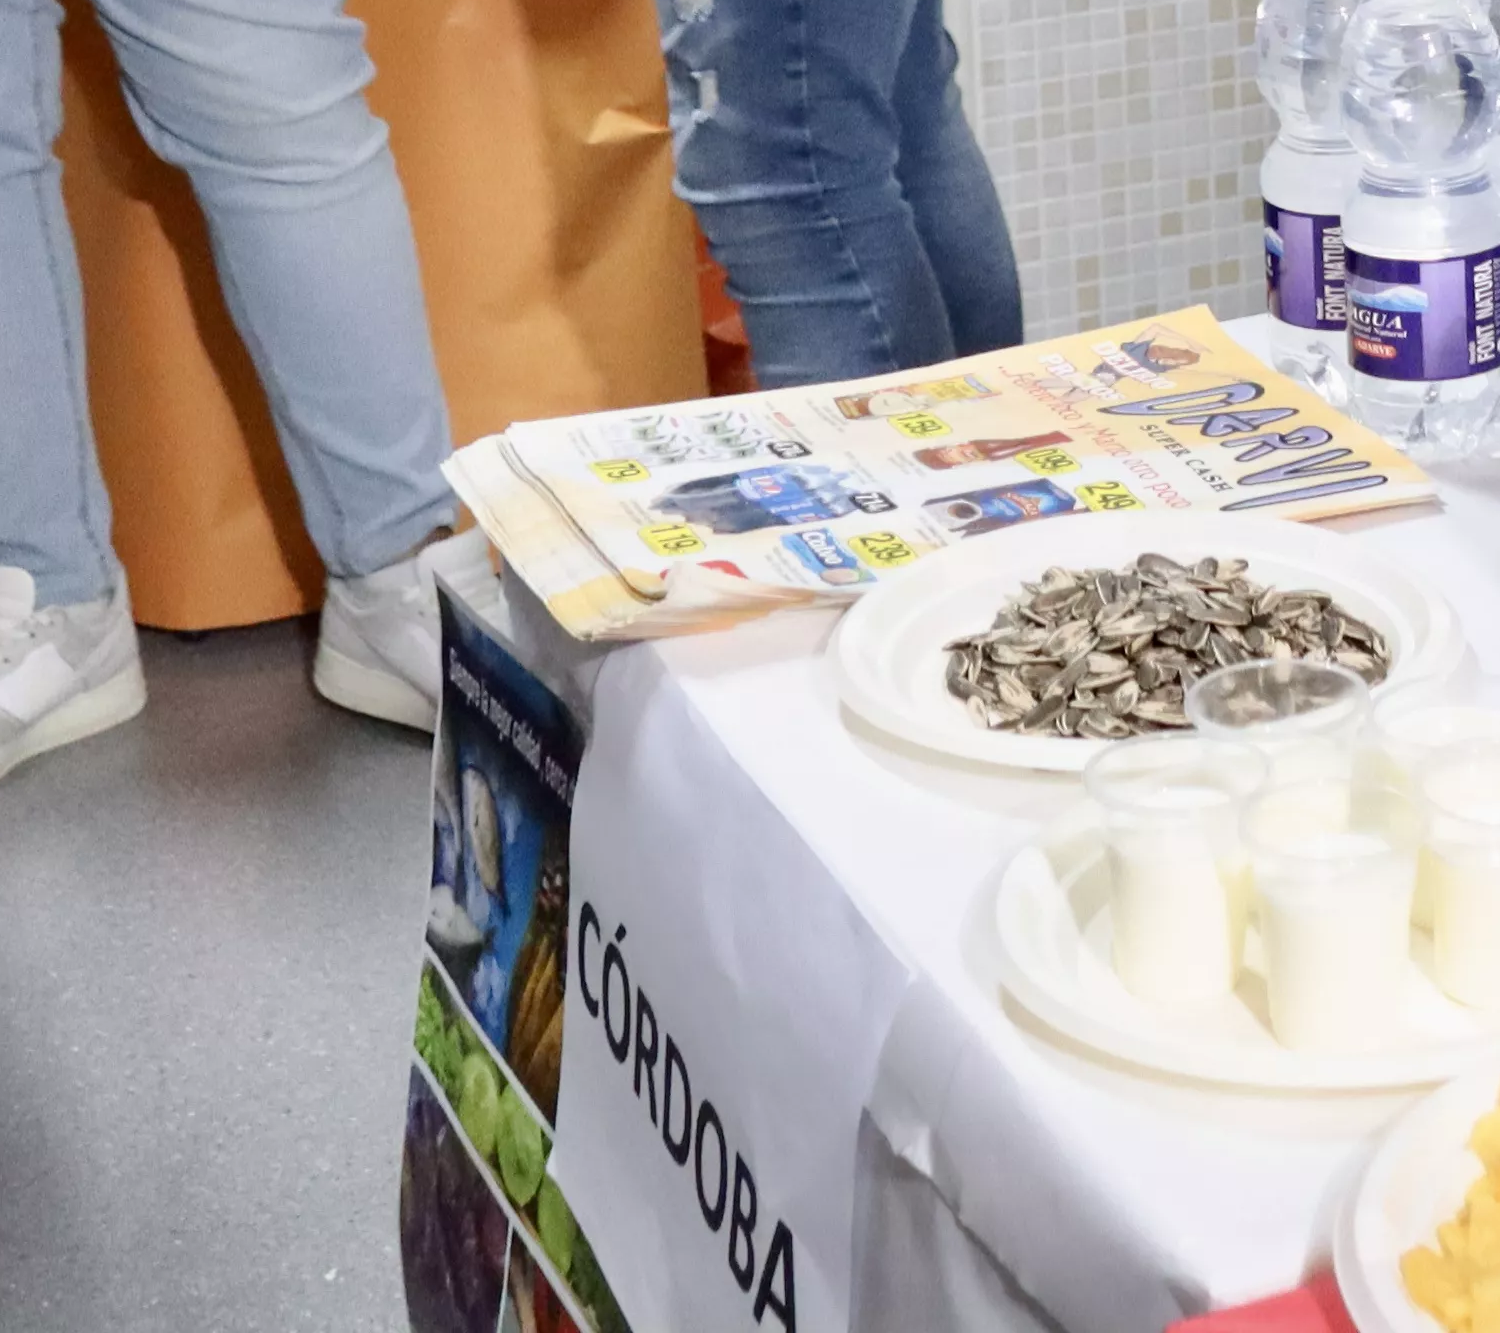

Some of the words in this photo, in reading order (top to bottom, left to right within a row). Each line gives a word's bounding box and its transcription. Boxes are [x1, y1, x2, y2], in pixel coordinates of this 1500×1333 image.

[1323, 226, 1346, 282] NATURA
[1324, 284, 1347, 322] FONT
[1474, 258, 1495, 321] NATURA
[1476, 323, 1496, 364] FONT
[1140, 424, 1191, 458] SUPER
[1186, 459, 1233, 493] CASH
[577, 900, 798, 1333] CÓRDOBA
